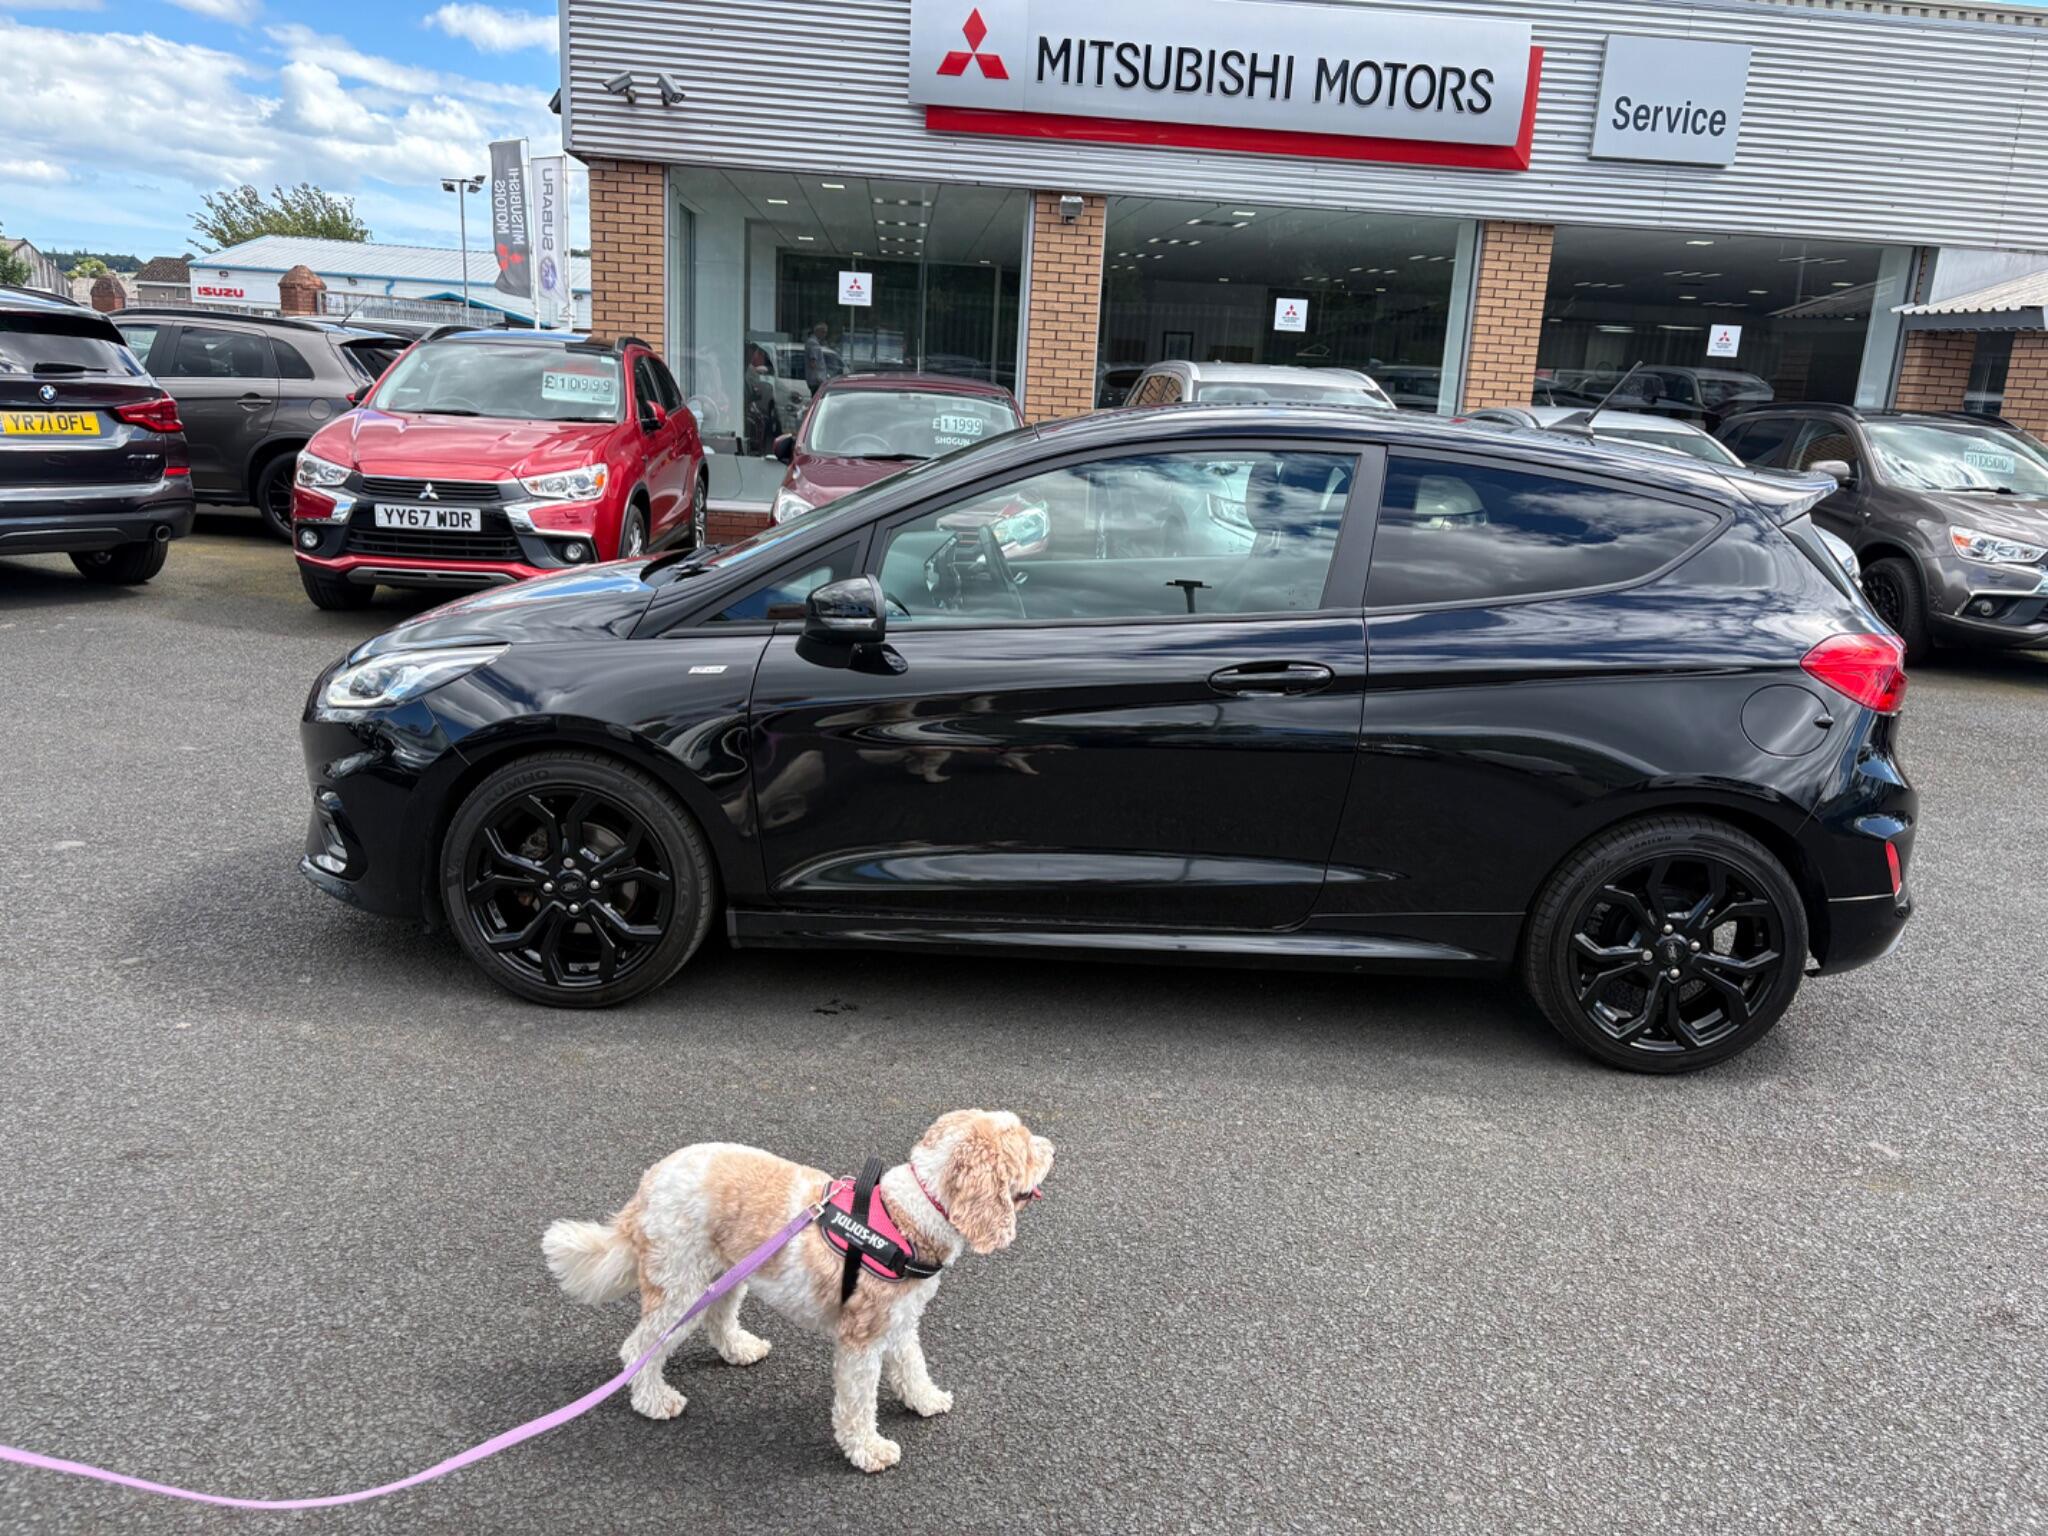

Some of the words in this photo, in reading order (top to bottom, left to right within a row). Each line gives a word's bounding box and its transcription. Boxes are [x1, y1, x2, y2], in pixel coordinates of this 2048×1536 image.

[1036, 35, 1295, 100] MITSUBISHI
[1314, 57, 1495, 114] MOTORS
[1611, 95, 1727, 137] Service
[197, 286, 245, 299] ISUZU
[9, 414, 53, 431] YR71
[56, 414, 93, 431] OFL
[383, 508, 431, 526] YY67
[437, 510, 473, 528] WDR
